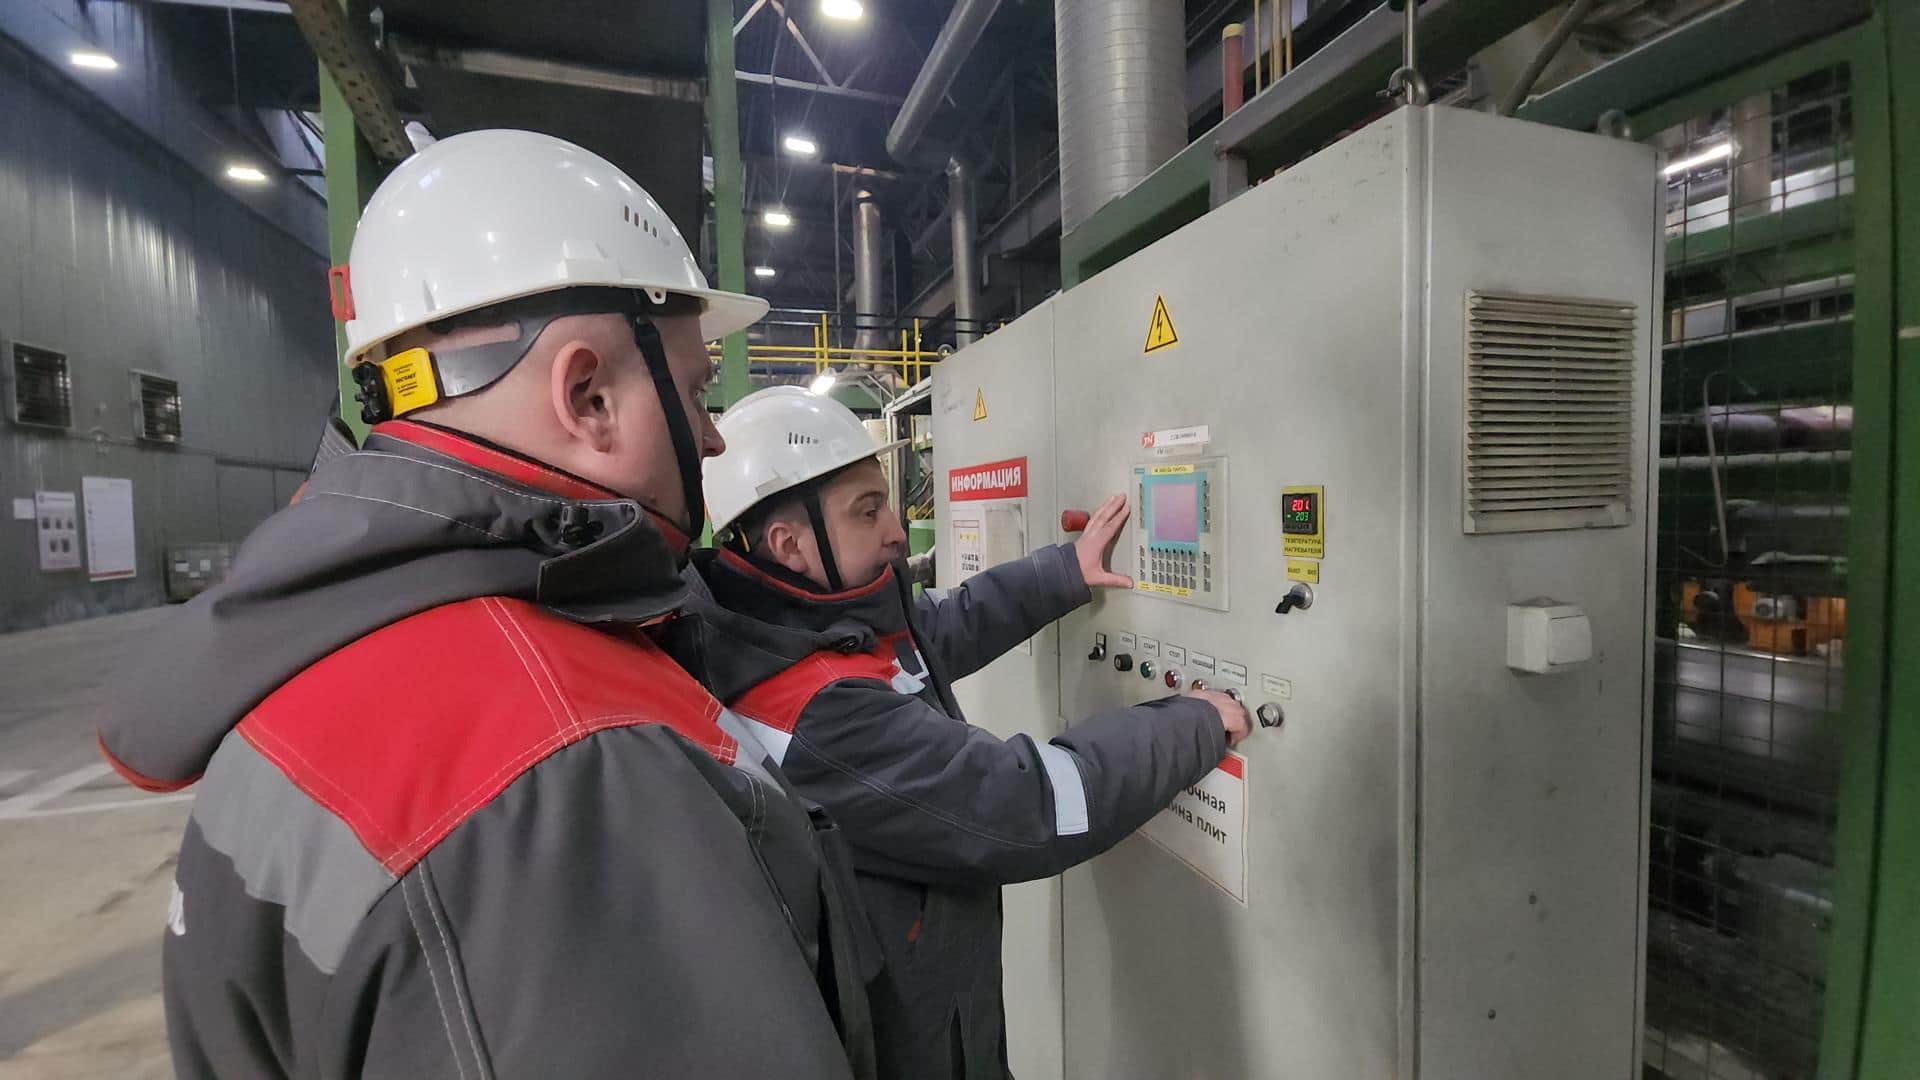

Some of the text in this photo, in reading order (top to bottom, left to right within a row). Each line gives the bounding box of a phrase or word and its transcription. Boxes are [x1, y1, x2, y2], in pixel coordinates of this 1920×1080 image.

[951, 466, 1021, 493] ИНФОРМАЦИЯ
[1296, 512, 1309, 521] 203
[1285, 537, 1321, 545] ТЕМПЕРАТУРА
[1197, 816, 1227, 844] плит
